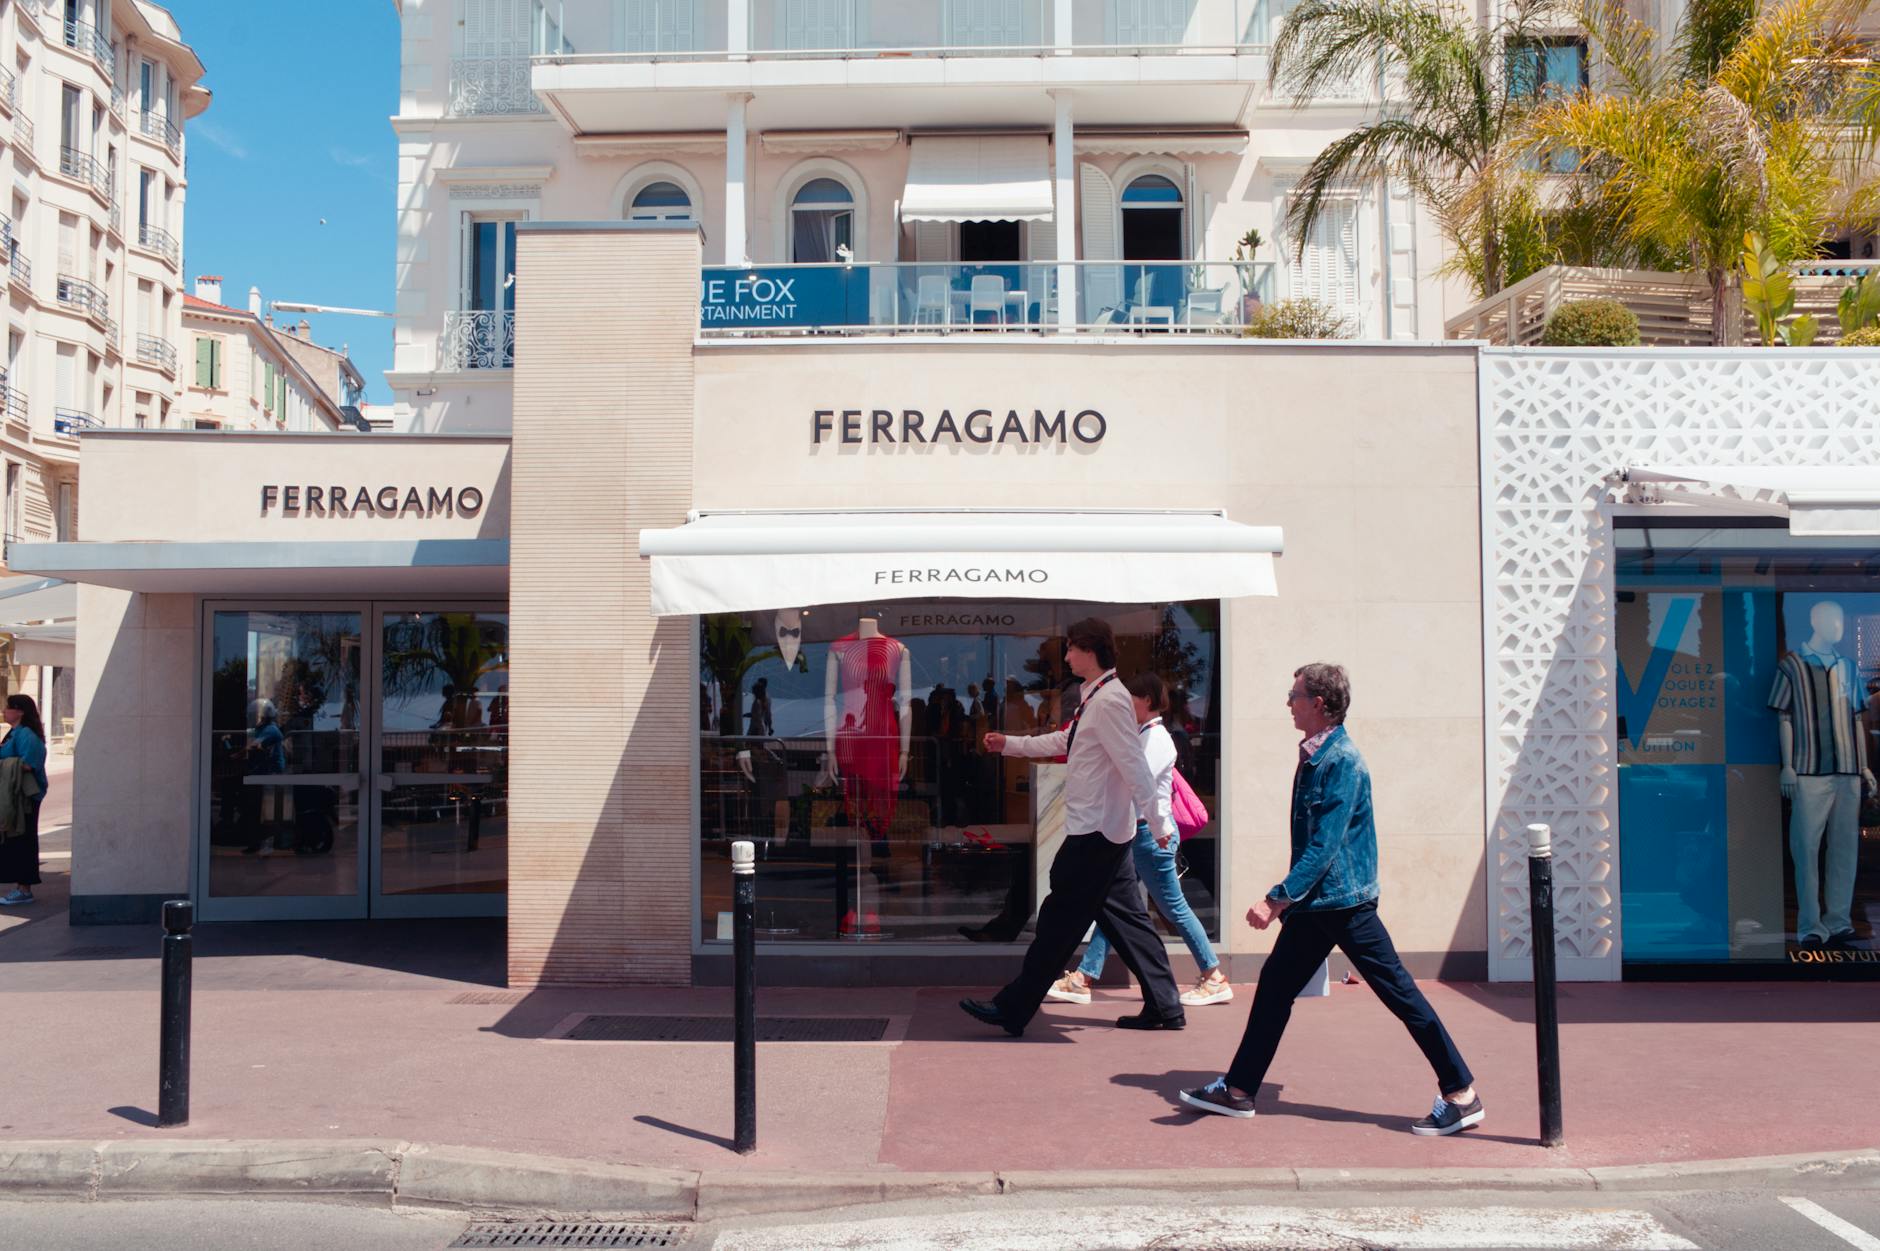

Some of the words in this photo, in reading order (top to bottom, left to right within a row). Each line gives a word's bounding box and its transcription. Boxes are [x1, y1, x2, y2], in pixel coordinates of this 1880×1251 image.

[735, 278, 796, 302] FOX
[812, 408, 1108, 444] FERRAGAMO
[262, 485, 484, 513] FERRAGAMO
[874, 568, 1049, 585] FERRAGAMO
[900, 614, 1016, 627] FERRAGAMO
[1789, 949, 1844, 963] LOUIS
[1844, 950, 1880, 963] VUI
